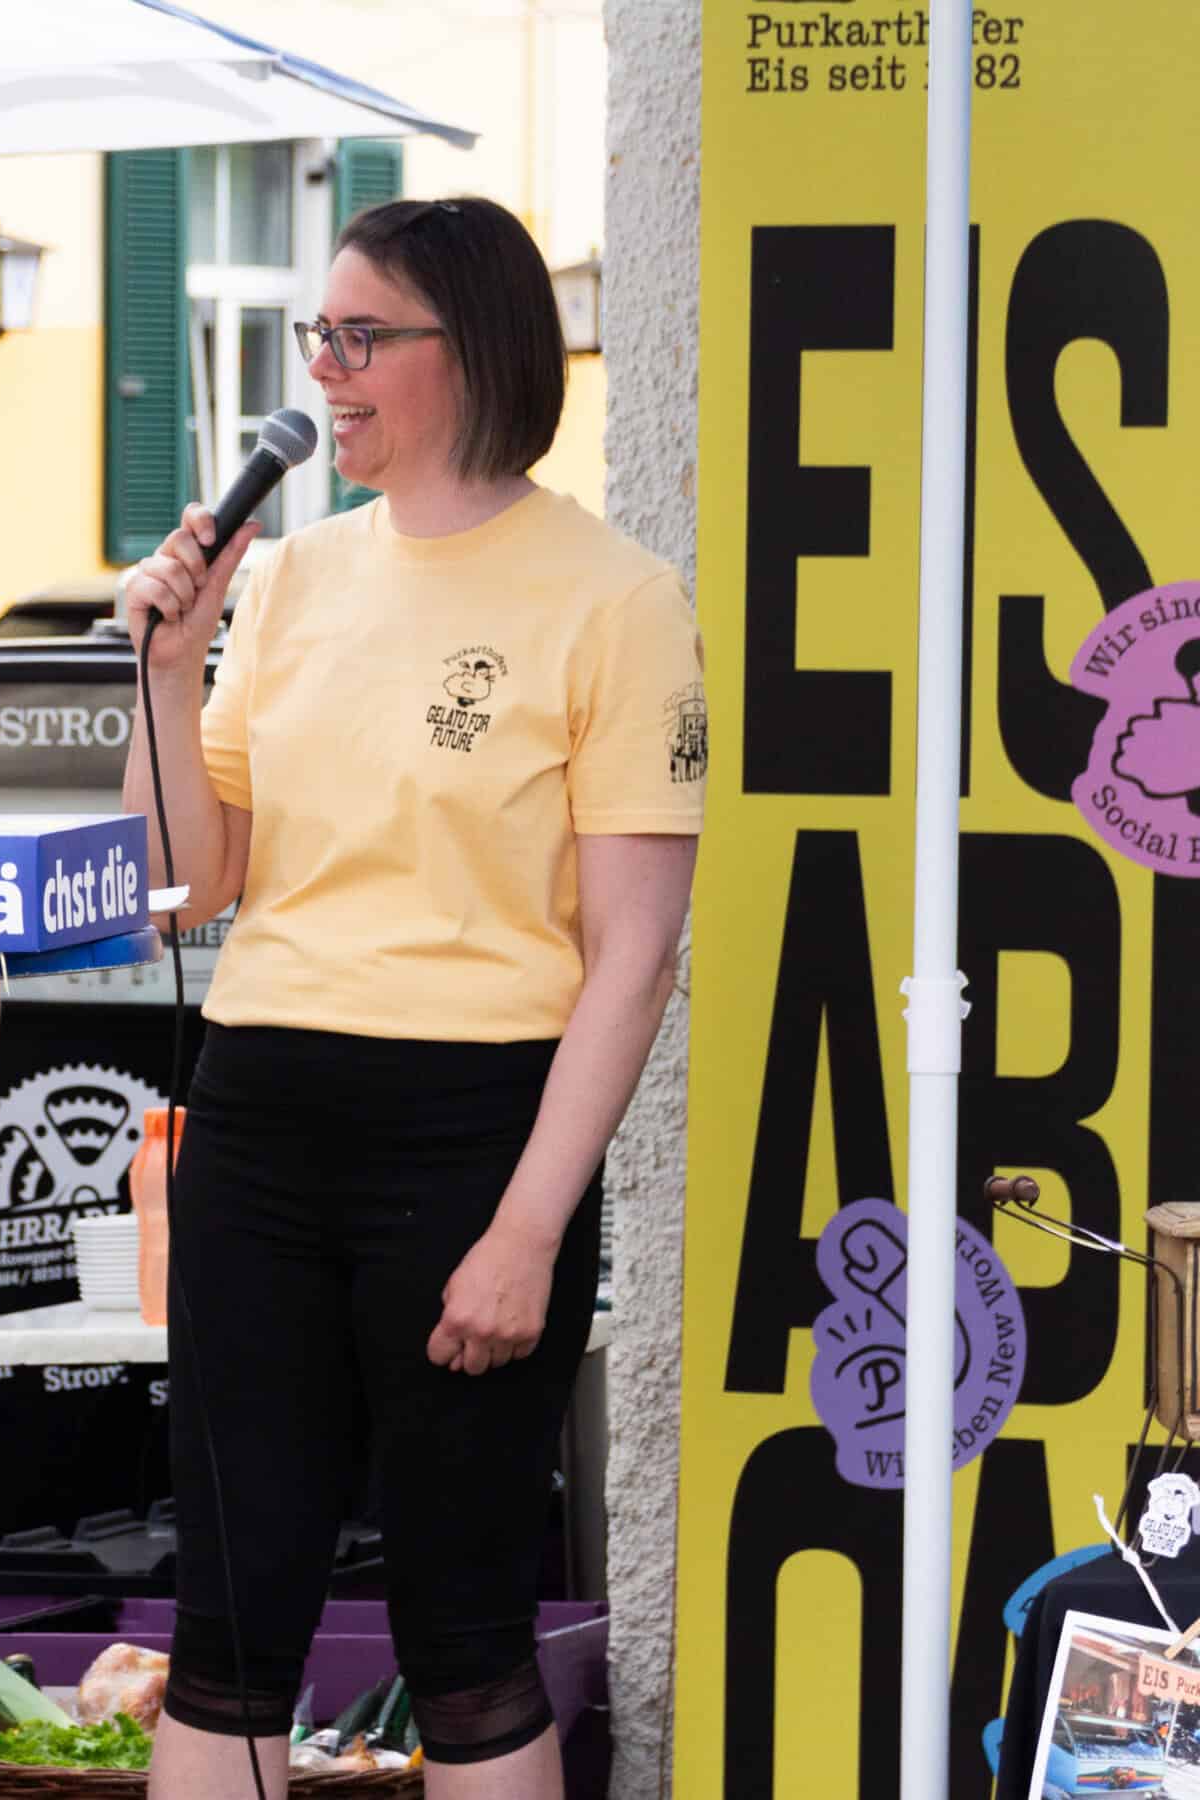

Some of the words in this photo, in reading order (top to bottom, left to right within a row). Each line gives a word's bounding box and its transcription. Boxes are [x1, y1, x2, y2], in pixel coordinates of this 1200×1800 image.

[746, 10, 1024, 48] Purkarthfer
[746, 58, 809, 93] Eis
[828, 55, 906, 91] seit
[923, 53, 1021, 90] 82
[742, 218, 1169, 802] ES
[1084, 624, 1138, 678] Wir
[426, 705, 468, 729] GELATO
[467, 713, 491, 734] FOR
[431, 726, 475, 752] FUTURE
[1091, 784, 1178, 861] Social
[42, 858, 97, 934] chst
[100, 845, 138, 922] die
[864, 1449, 905, 1479] Wi
[987, 1312, 1016, 1388] New
